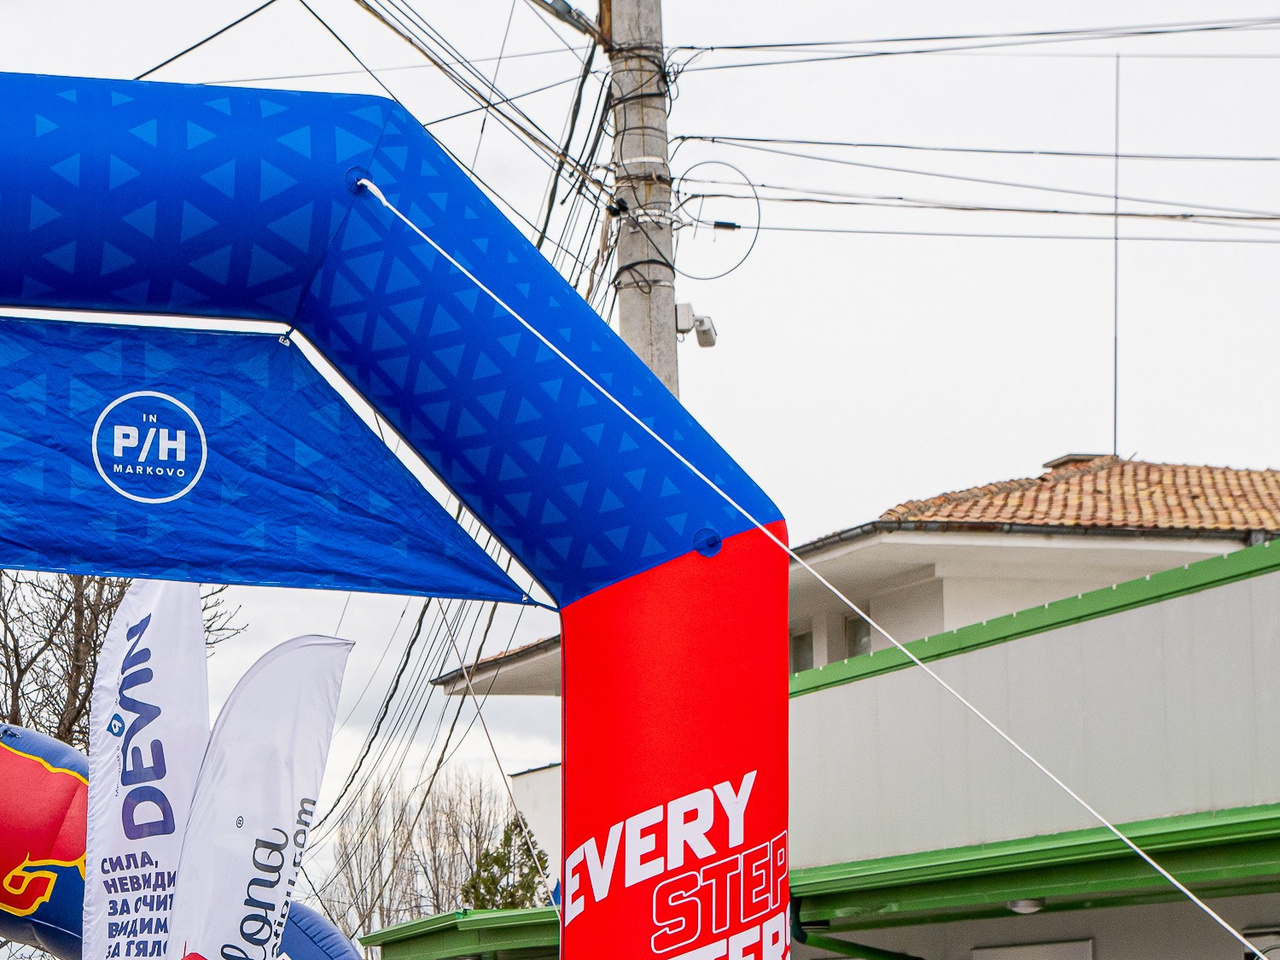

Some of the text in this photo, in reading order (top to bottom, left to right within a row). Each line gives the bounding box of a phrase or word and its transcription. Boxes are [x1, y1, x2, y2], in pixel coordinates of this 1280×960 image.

[143, 413, 157, 423] IN
[114, 425, 186, 462] P/H
[113, 464, 185, 477] MARKOVO
[119, 613, 175, 840] DEVIN
[101, 851, 158, 874] СИЛА,
[565, 770, 757, 927] EVERY
[651, 830, 788, 953] STEP
[108, 899, 130, 916] ЗА
